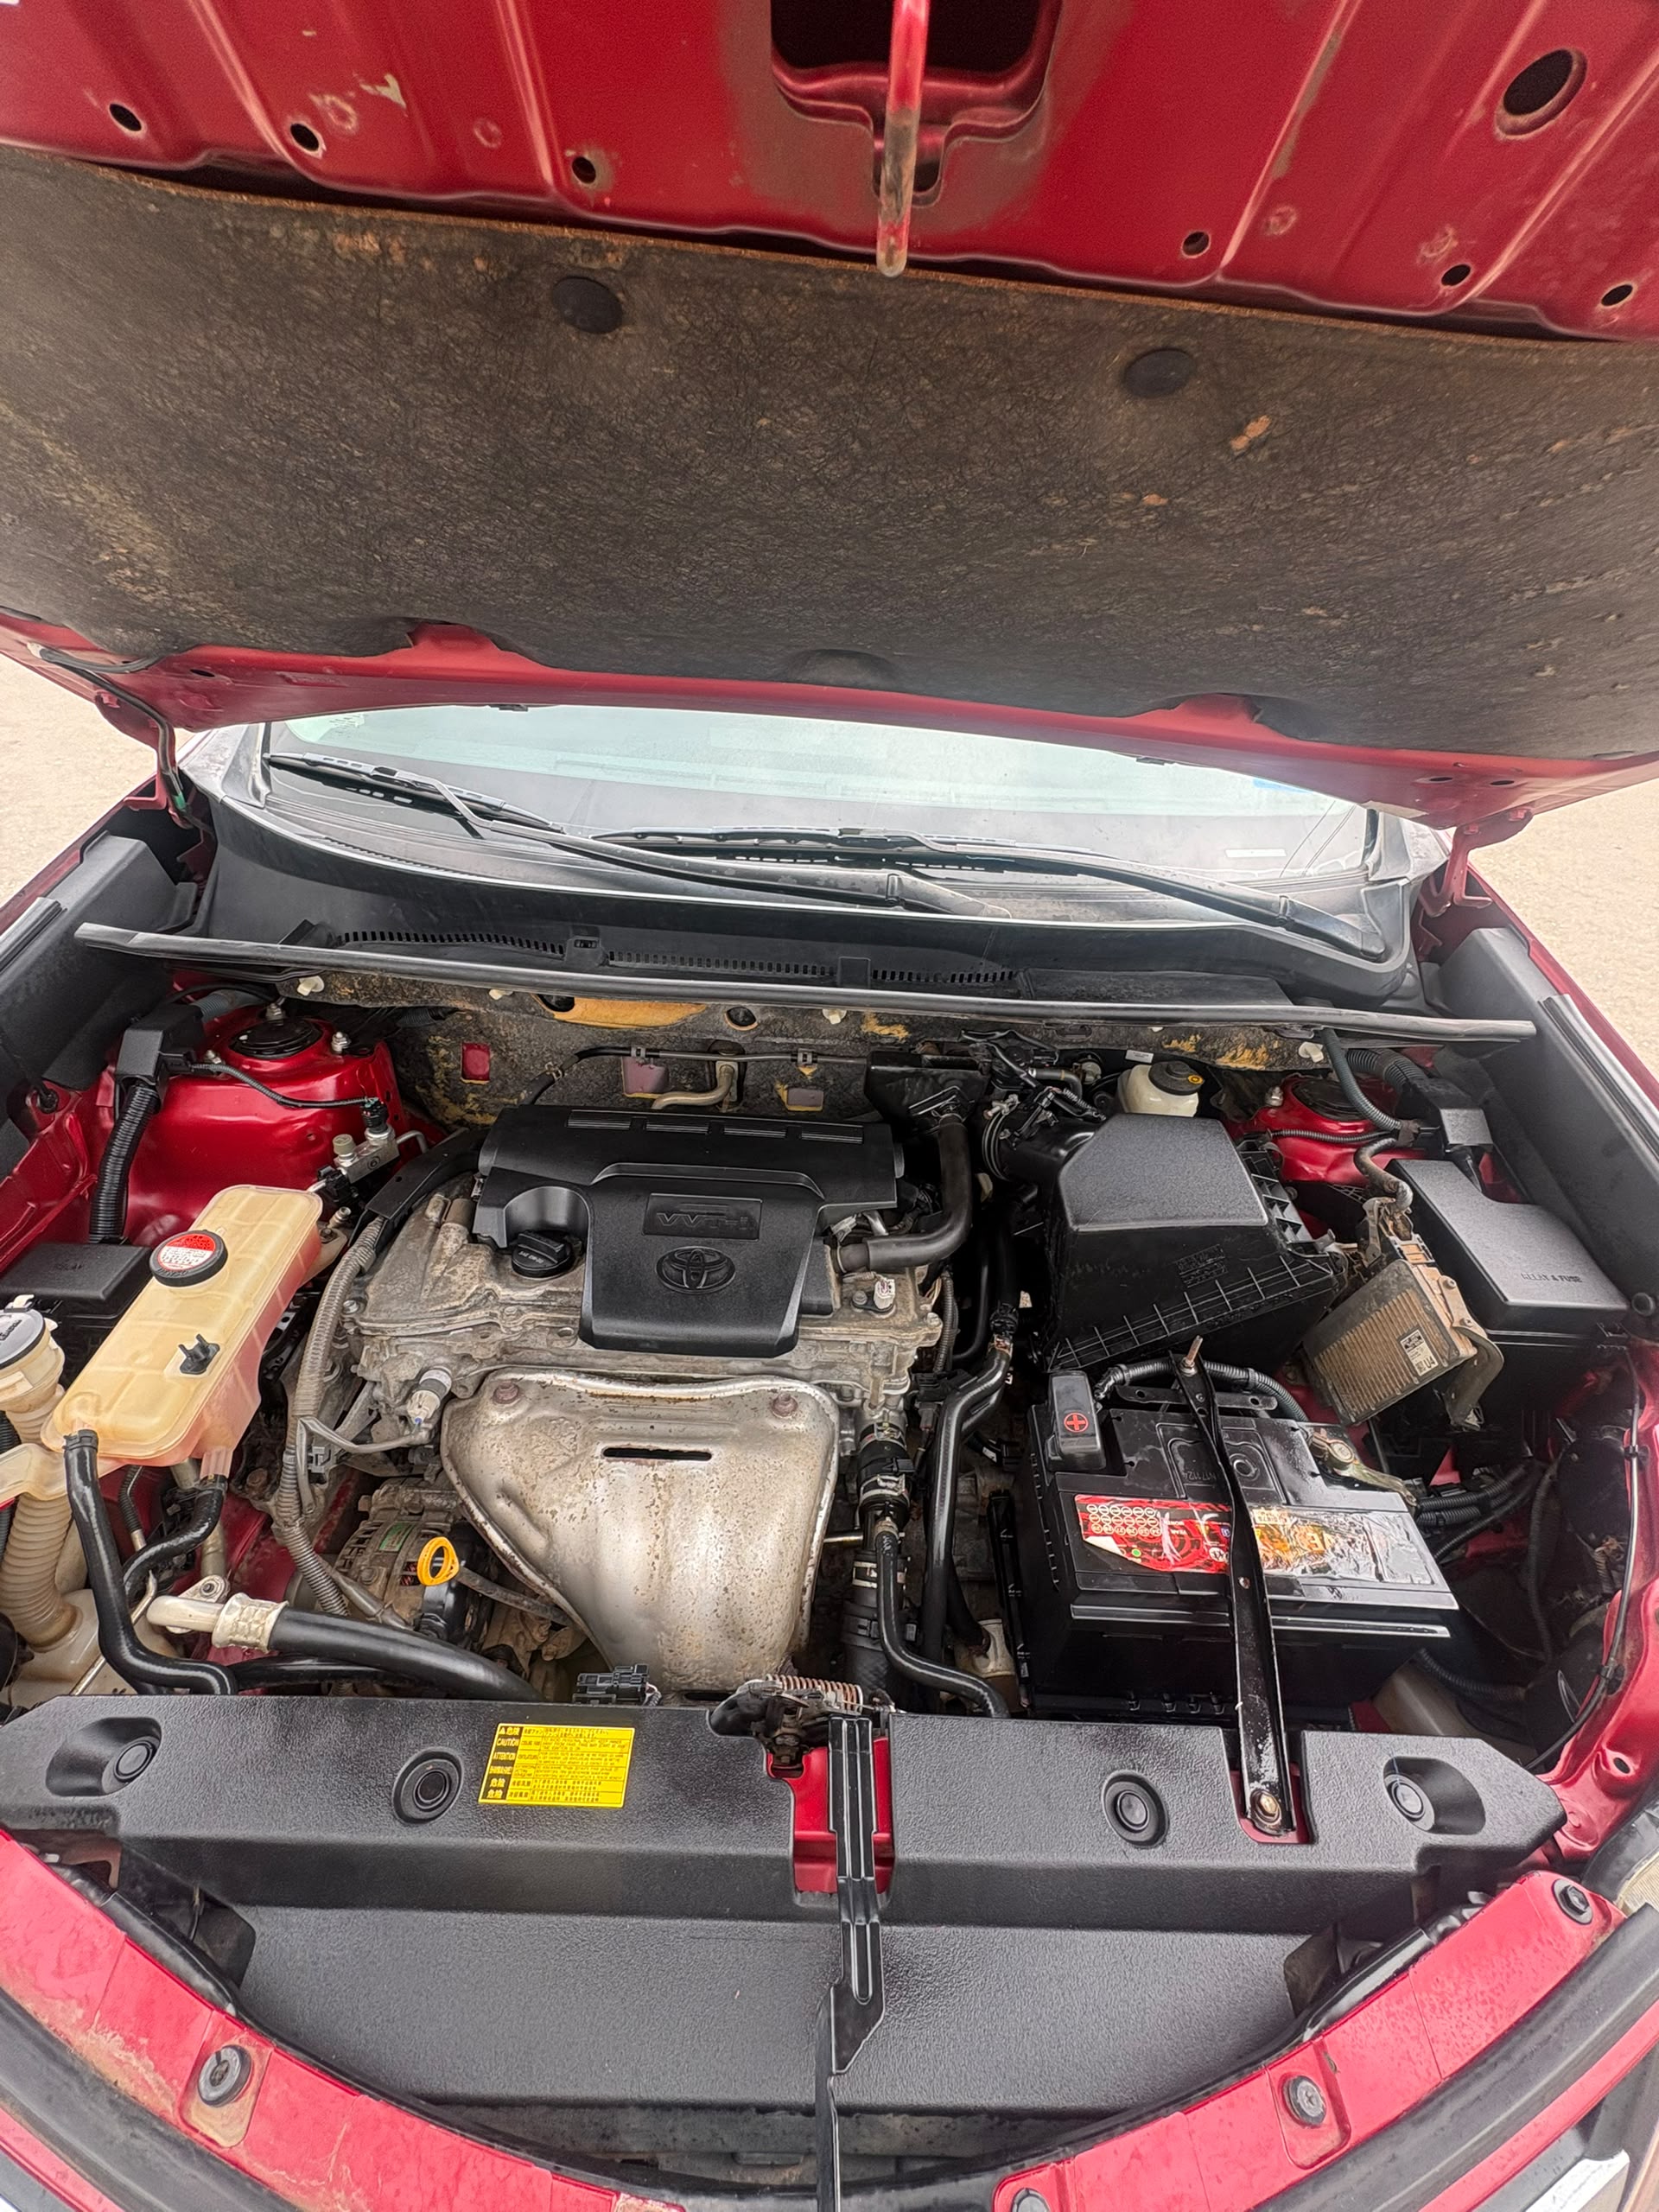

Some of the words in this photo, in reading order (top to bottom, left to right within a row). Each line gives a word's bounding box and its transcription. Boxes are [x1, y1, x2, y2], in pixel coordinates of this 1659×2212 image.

[1520, 1272, 1550, 1281] RELAY
[1558, 1274, 1583, 1283] FUSE
[1423, 1355, 1436, 1369] U4
[496, 1738, 519, 1746] CAUTION
[493, 1751, 516, 1760] ATTENTION
